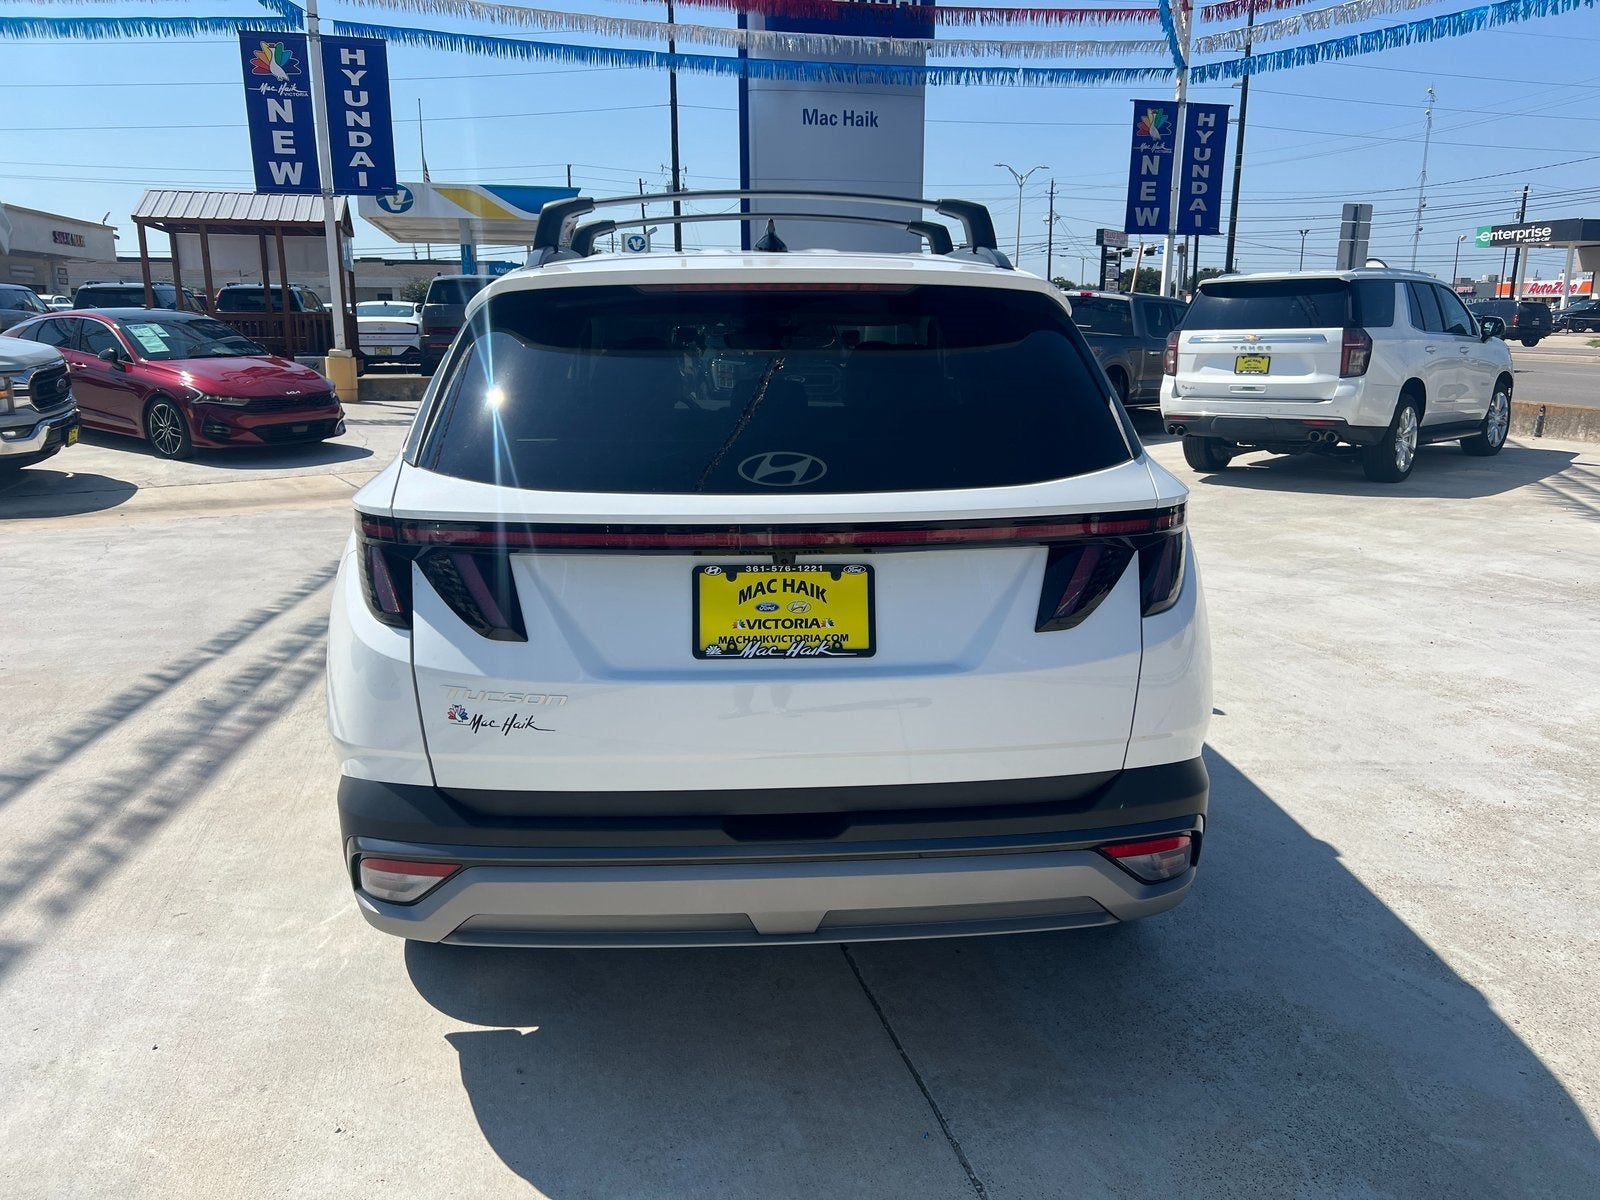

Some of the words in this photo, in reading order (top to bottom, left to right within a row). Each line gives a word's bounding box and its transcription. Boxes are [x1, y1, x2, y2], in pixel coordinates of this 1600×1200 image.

[250, 82, 277, 95] Mac
[278, 82, 305, 96] Haik
[340, 49, 376, 188] HYUNDAI
[801, 108, 838, 126] Mac
[843, 108, 879, 126] Haik
[267, 98, 304, 186] NEW
[1188, 112, 1217, 228] HYUNDAI
[1135, 154, 1160, 227] NEW
[1477, 225, 1552, 242] enterprise
[738, 578, 778, 606] MAC
[782, 577, 828, 604] HAIK
[745, 617, 821, 630] VICTORIA
[740, 640, 784, 659] Mac
[784, 639, 840, 658] Haik
[462, 713, 500, 734] Mac
[501, 713, 547, 736] Haik
